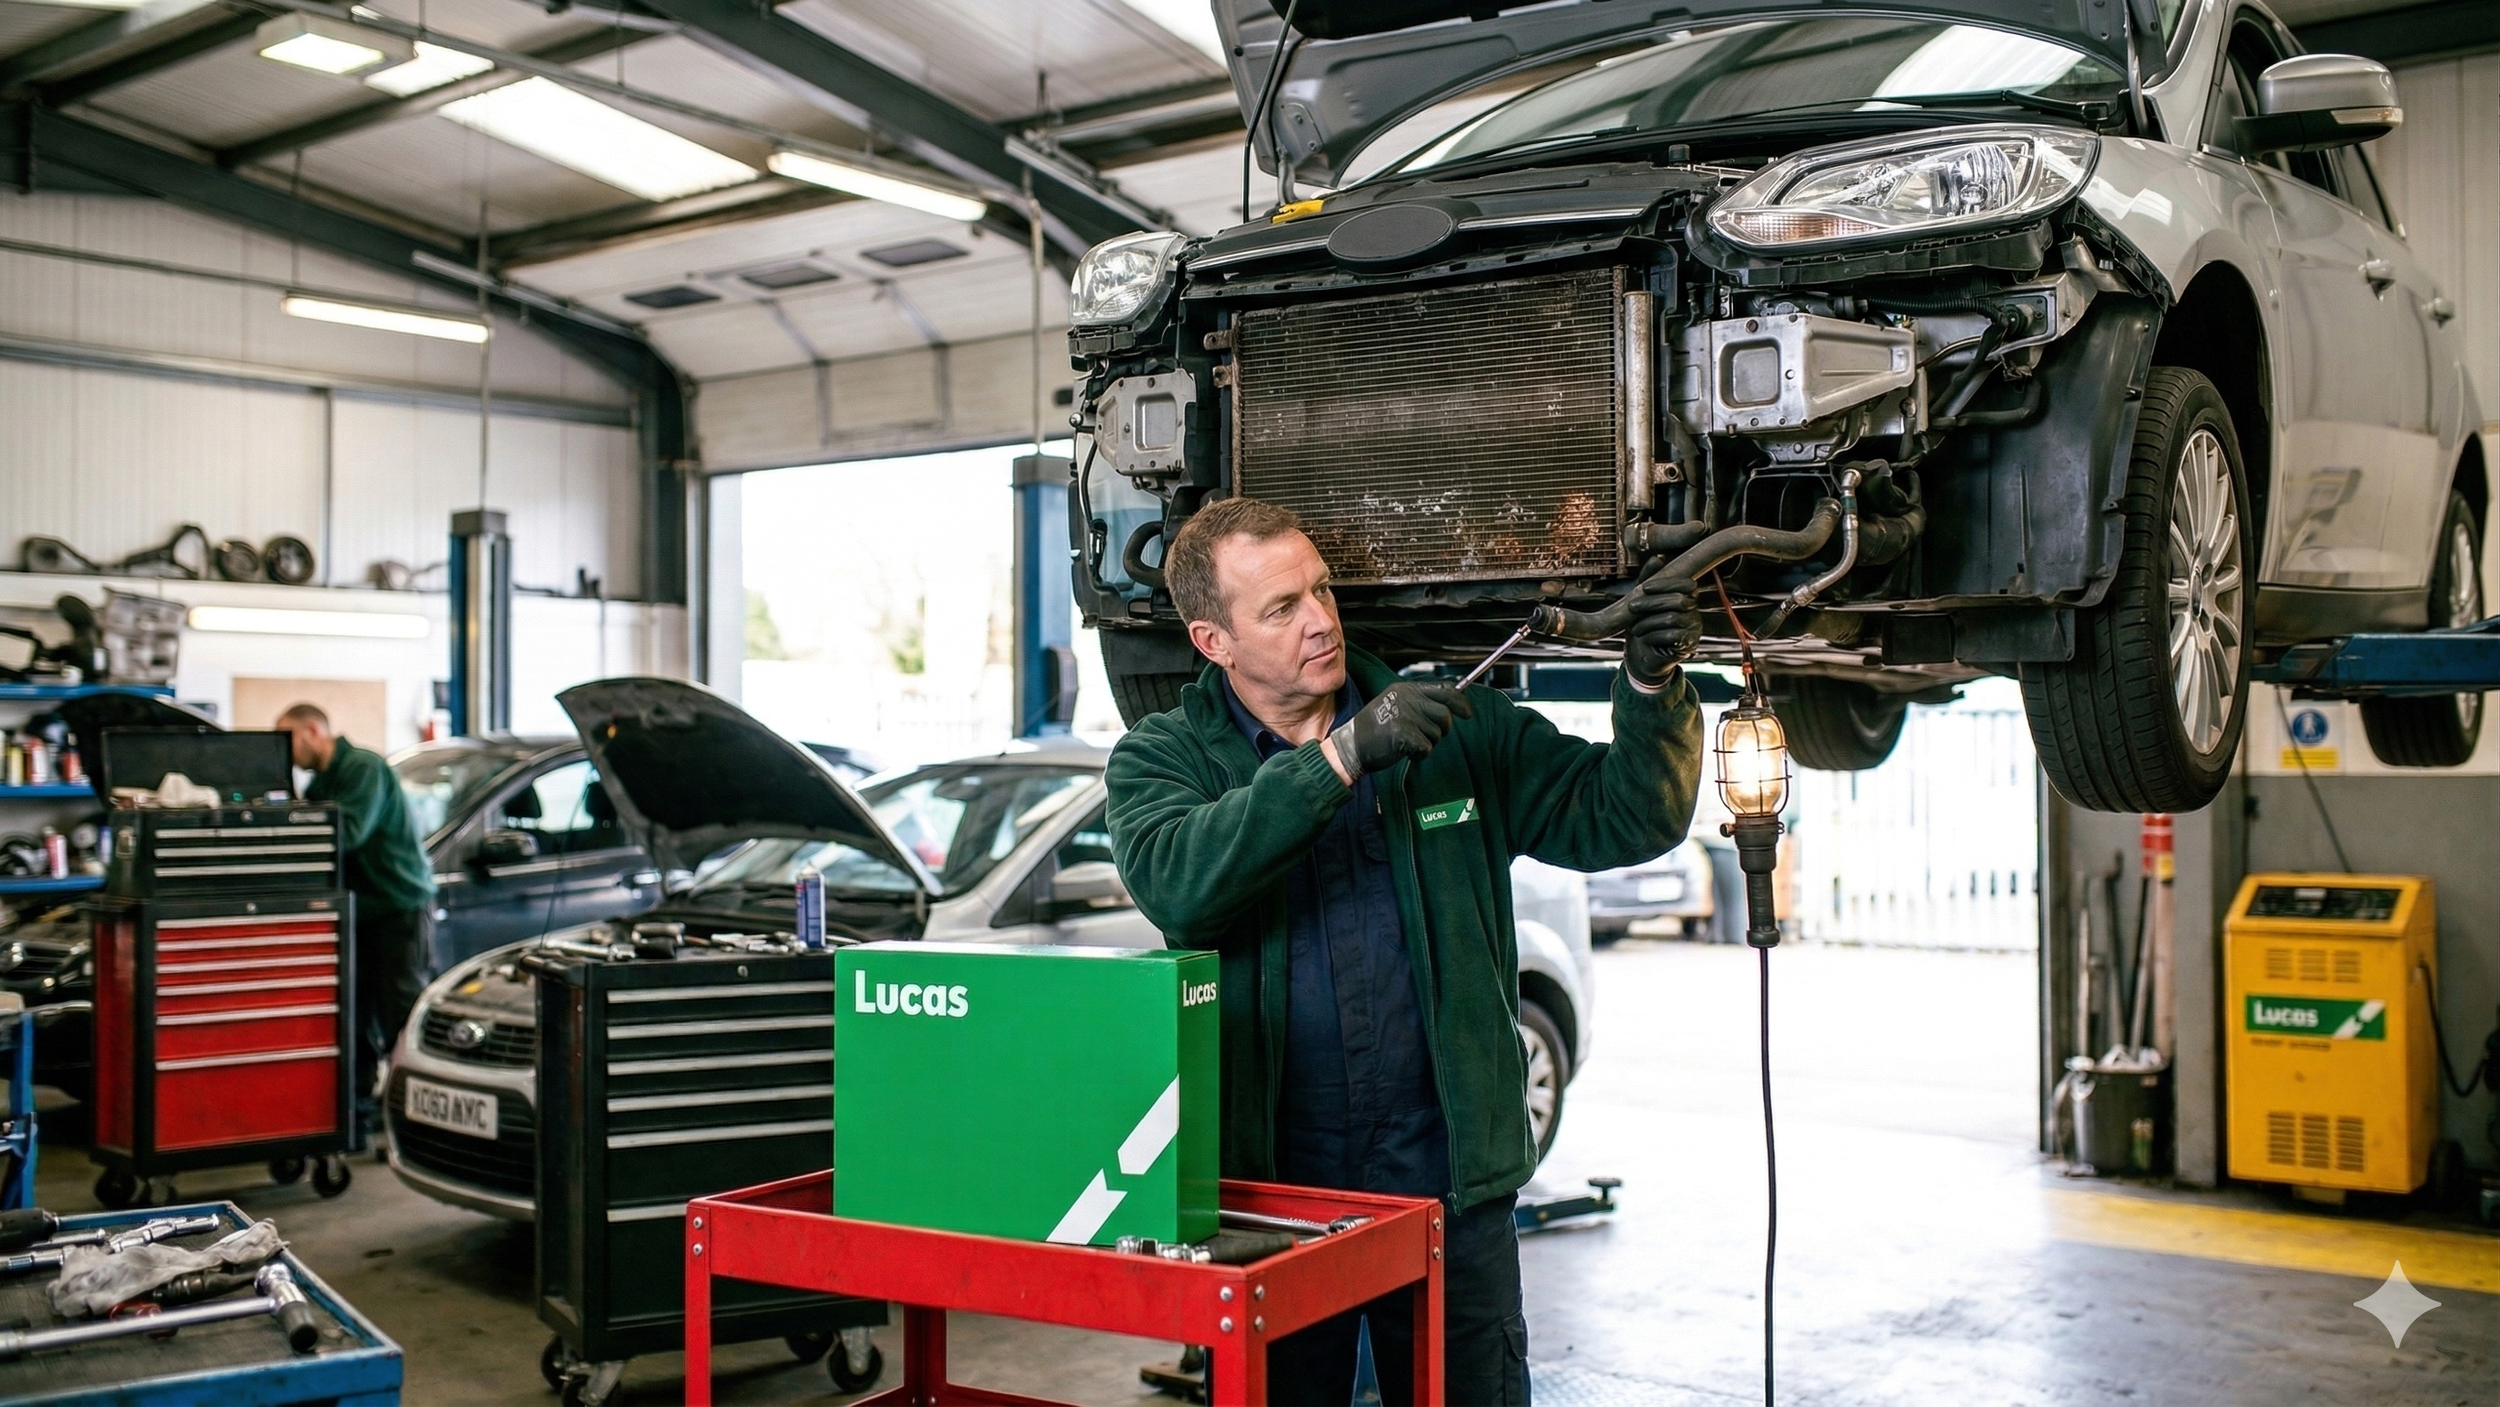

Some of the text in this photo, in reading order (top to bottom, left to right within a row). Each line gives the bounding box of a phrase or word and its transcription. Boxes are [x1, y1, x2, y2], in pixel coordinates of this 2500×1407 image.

[855, 969, 969, 1018] Lucas
[1182, 979, 1217, 1008] Lucas
[2253, 999, 2320, 1028] Lucas
